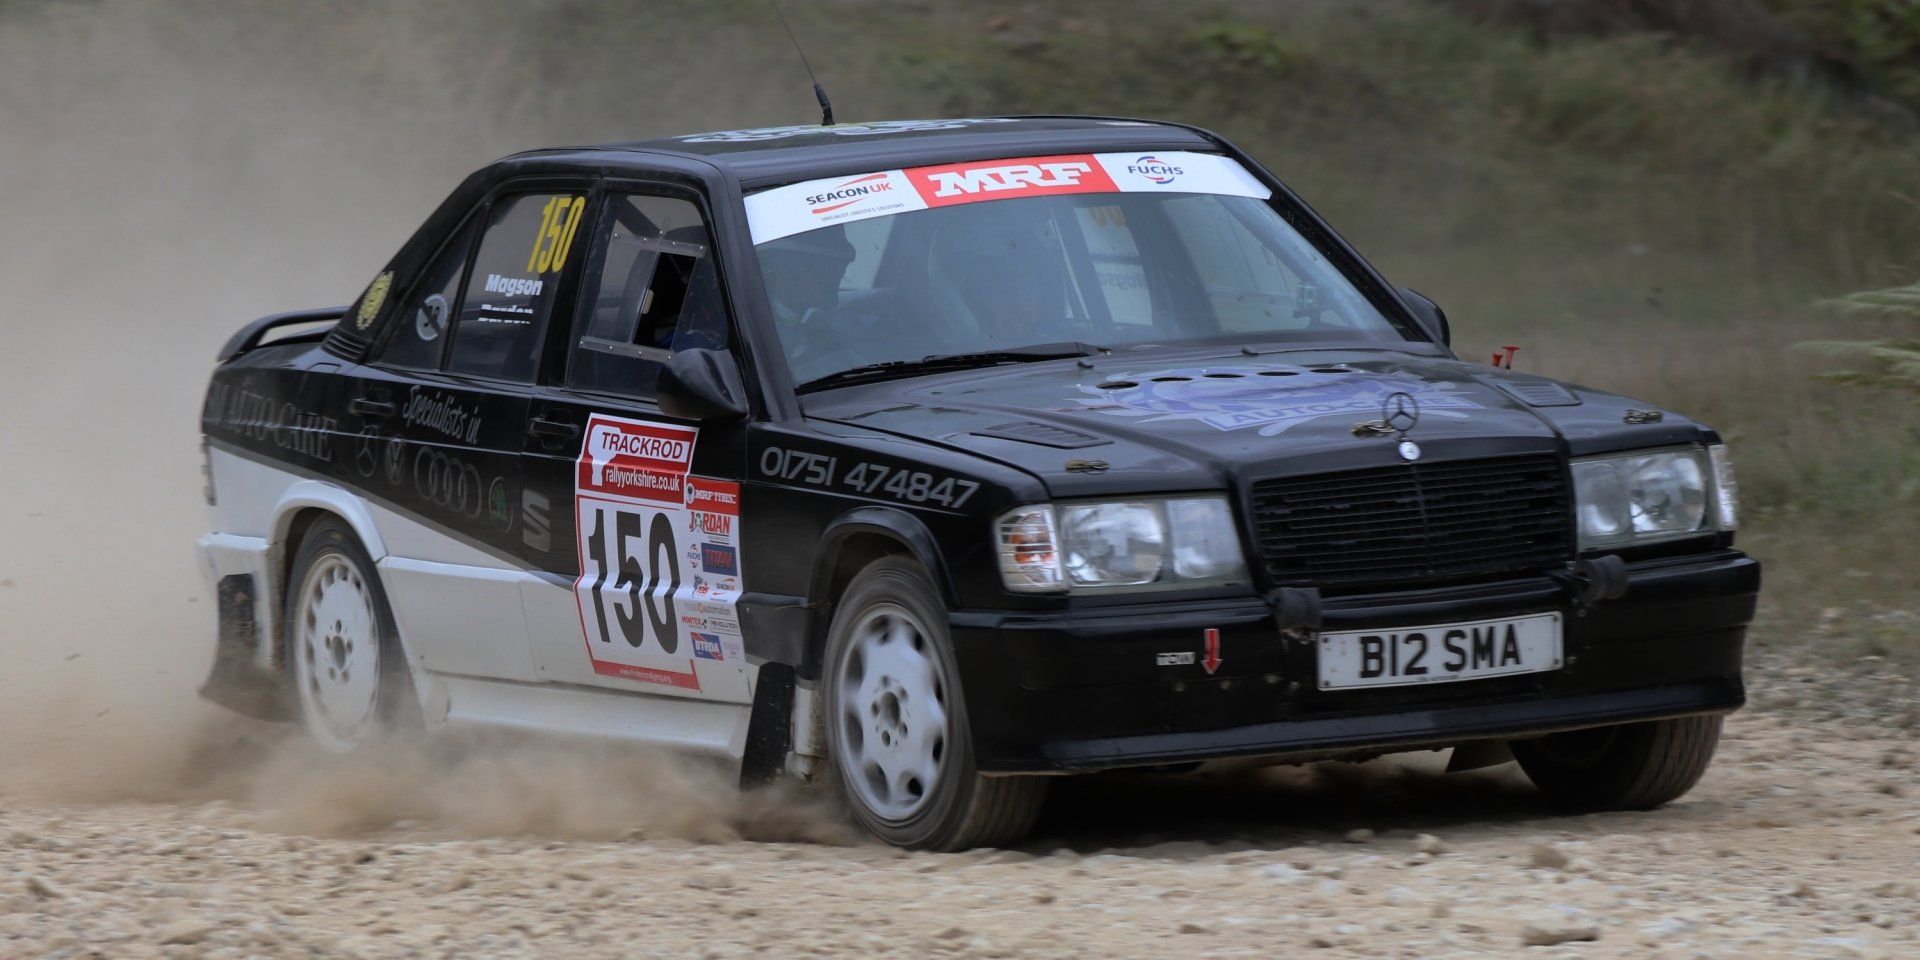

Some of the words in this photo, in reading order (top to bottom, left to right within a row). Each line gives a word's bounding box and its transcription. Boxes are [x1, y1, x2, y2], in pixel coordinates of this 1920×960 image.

[927, 162, 1092, 198] MRF
[1127, 164, 1184, 176] FUCHS
[527, 196, 586, 273] 150
[485, 274, 543, 297] Magson
[402, 384, 468, 439] Specialists
[466, 406, 481, 444] in
[602, 432, 683, 460] TRACKROD
[605, 466, 680, 492] rallyyorkshire.co.uk
[760, 447, 837, 486] 01751
[844, 462, 980, 508] 474847
[687, 551, 702, 561] FUCHS
[588, 508, 681, 654] 150
[1442, 622, 1522, 672] SMA
